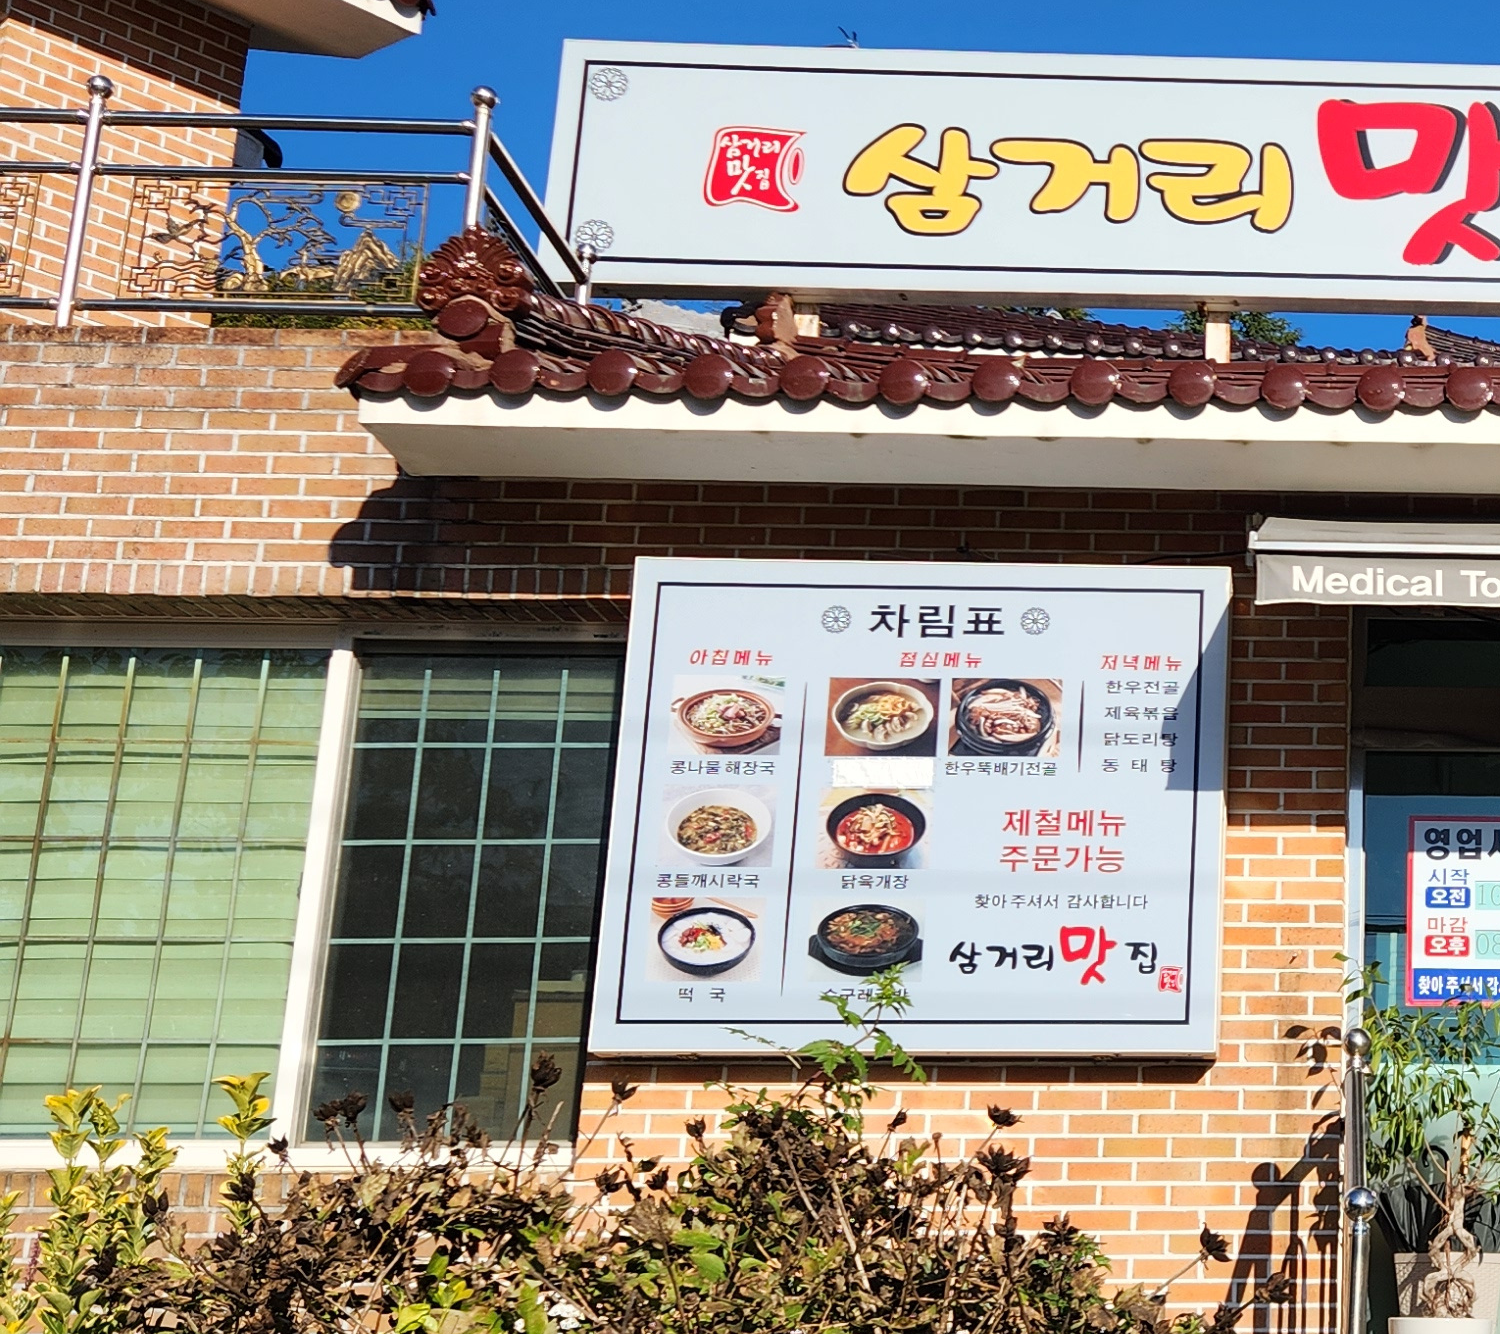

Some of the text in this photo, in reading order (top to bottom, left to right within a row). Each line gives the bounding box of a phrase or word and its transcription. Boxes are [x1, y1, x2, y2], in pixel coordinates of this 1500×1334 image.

[720, 134, 781, 158] 삼거리
[726, 154, 770, 195] 맛집
[1292, 565, 1443, 598] Medical
[868, 604, 1005, 638] 차림표
[689, 649, 774, 666] 아침메뉴
[900, 652, 983, 668] 점심메뉴
[1100, 655, 1183, 671] 저녁메뉴
[1106, 680, 1180, 694] 한우전골
[1105, 706, 1179, 720] 제육볶음
[1104, 732, 1178, 747] 닭도리탕
[670, 760, 776, 775] 콩나물 해장국
[944, 761, 1058, 776] 한우뚝배기전골
[1002, 809, 1126, 837] 제철메뉴
[999, 845, 1125, 873] 주문가능
[656, 873, 760, 889] 콩들깨시락국
[841, 875, 909, 889] 닭육개장
[1428, 868, 1470, 885] 시작
[975, 894, 1148, 910] 찾아 주셔서 감사합니다
[1431, 889, 1466, 906] 오전
[1427, 917, 1468, 933] 마감
[1429, 937, 1466, 955] 오후
[1418, 976, 1443, 995] 찾아
